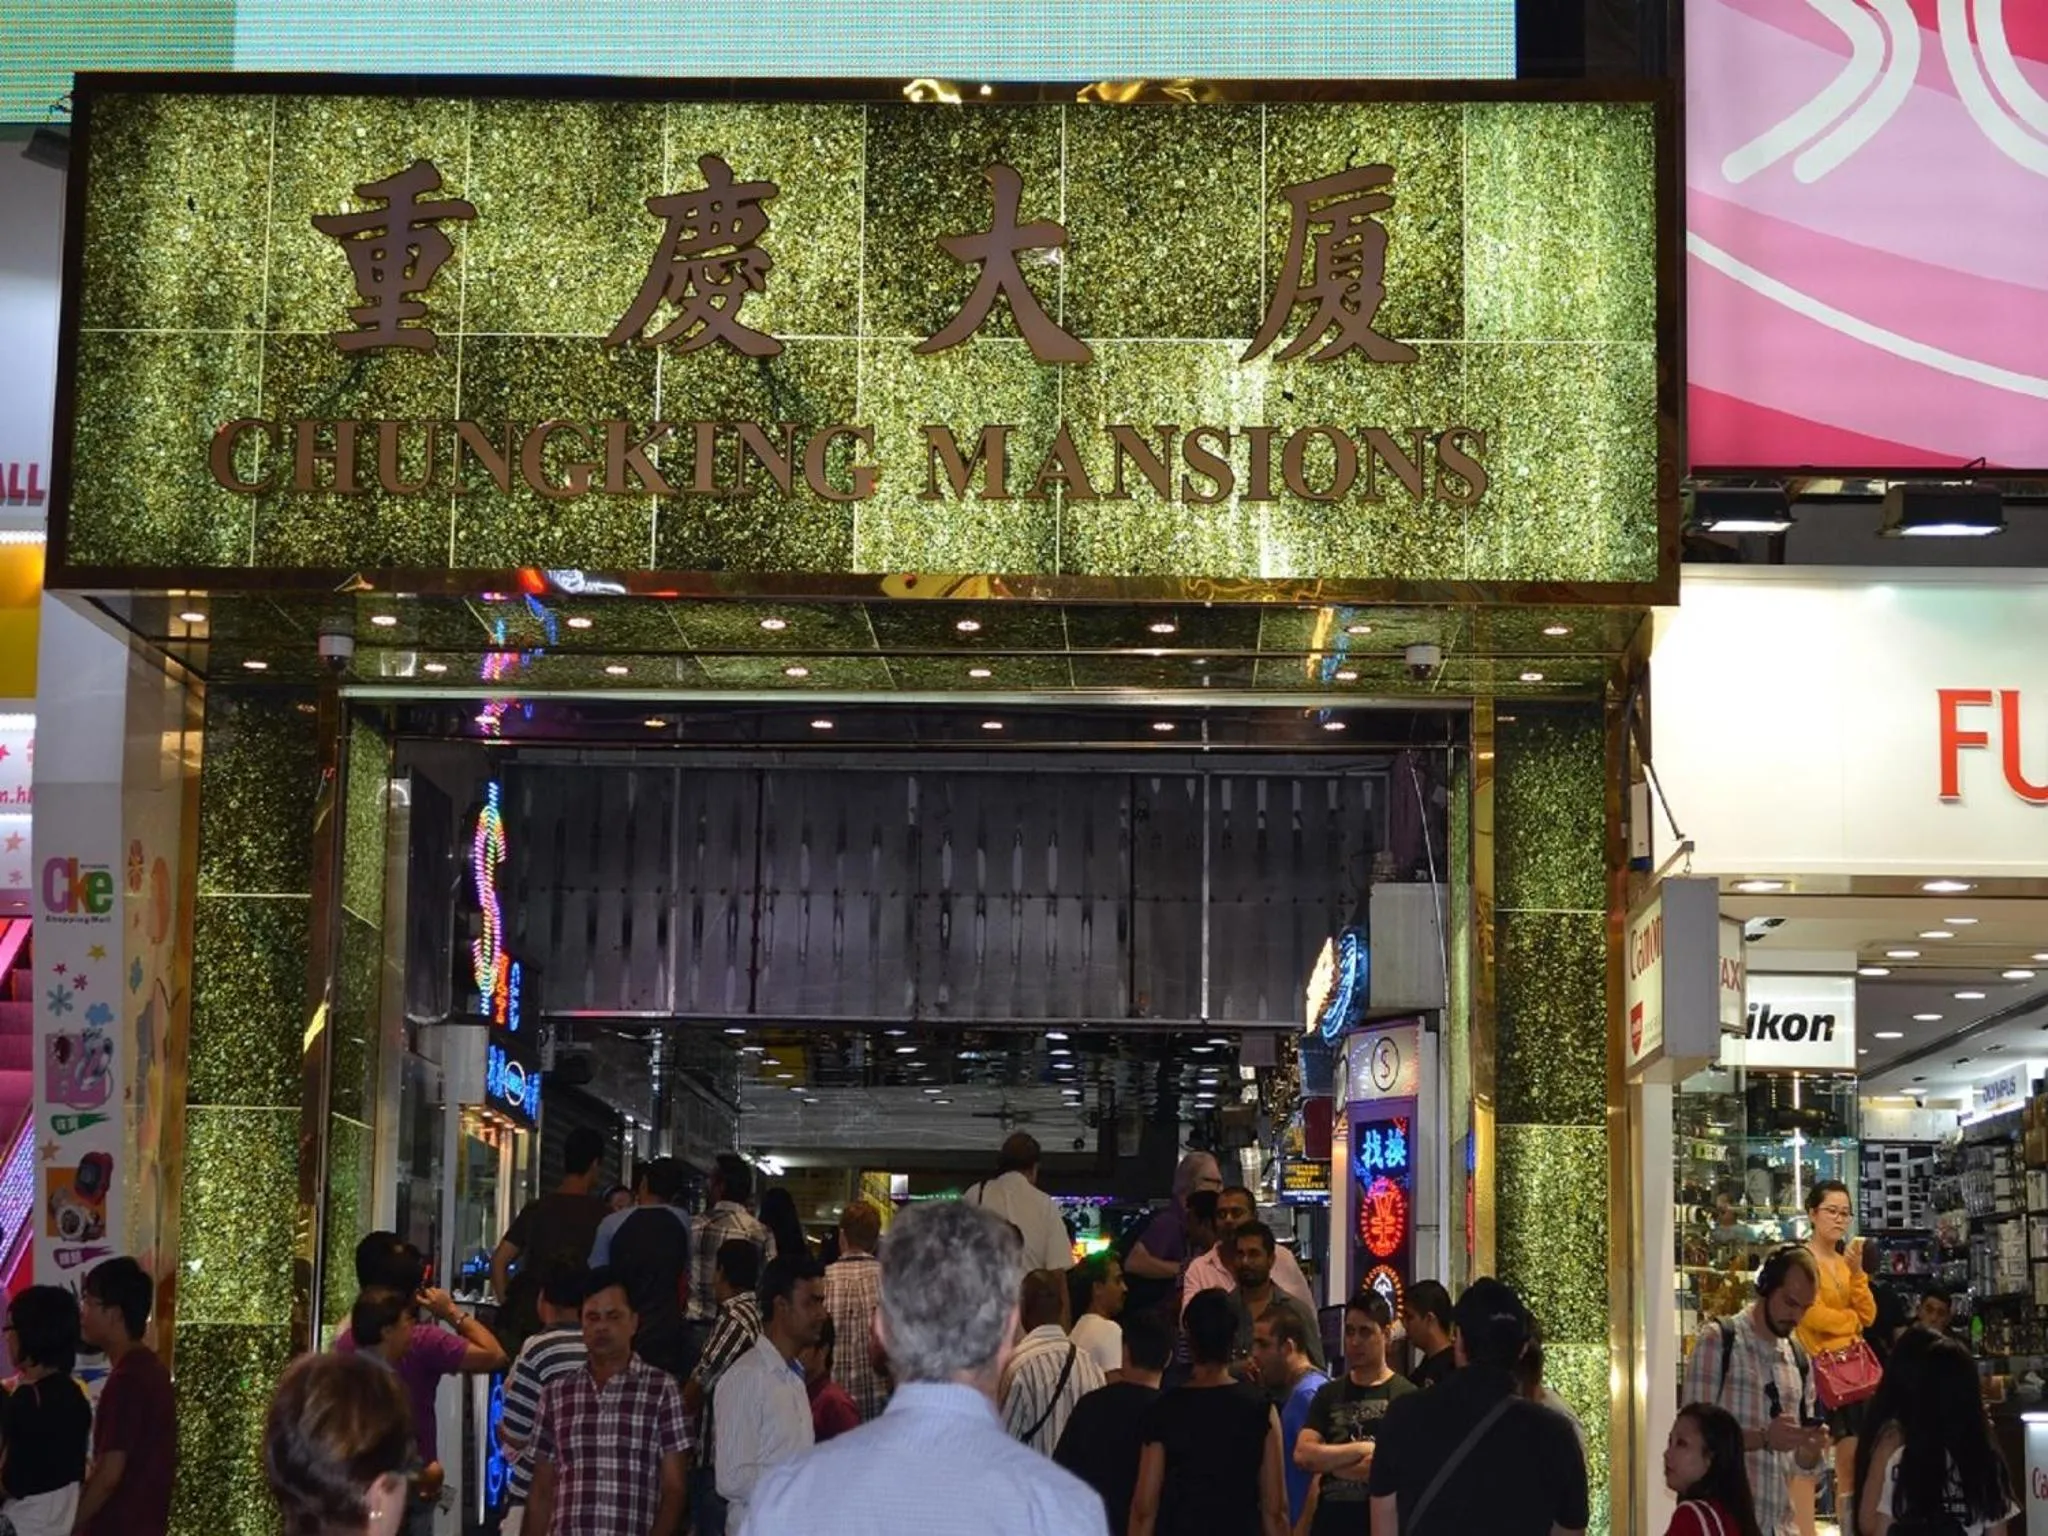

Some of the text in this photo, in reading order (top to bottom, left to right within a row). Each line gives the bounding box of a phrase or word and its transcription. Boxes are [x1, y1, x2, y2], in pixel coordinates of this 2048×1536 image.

[209, 417, 1489, 505] CHUNGKING MANSIONS
[0, 463, 47, 507] LL
[1719, 957, 1741, 992] AX
[1744, 1002, 1836, 1042] ikon
